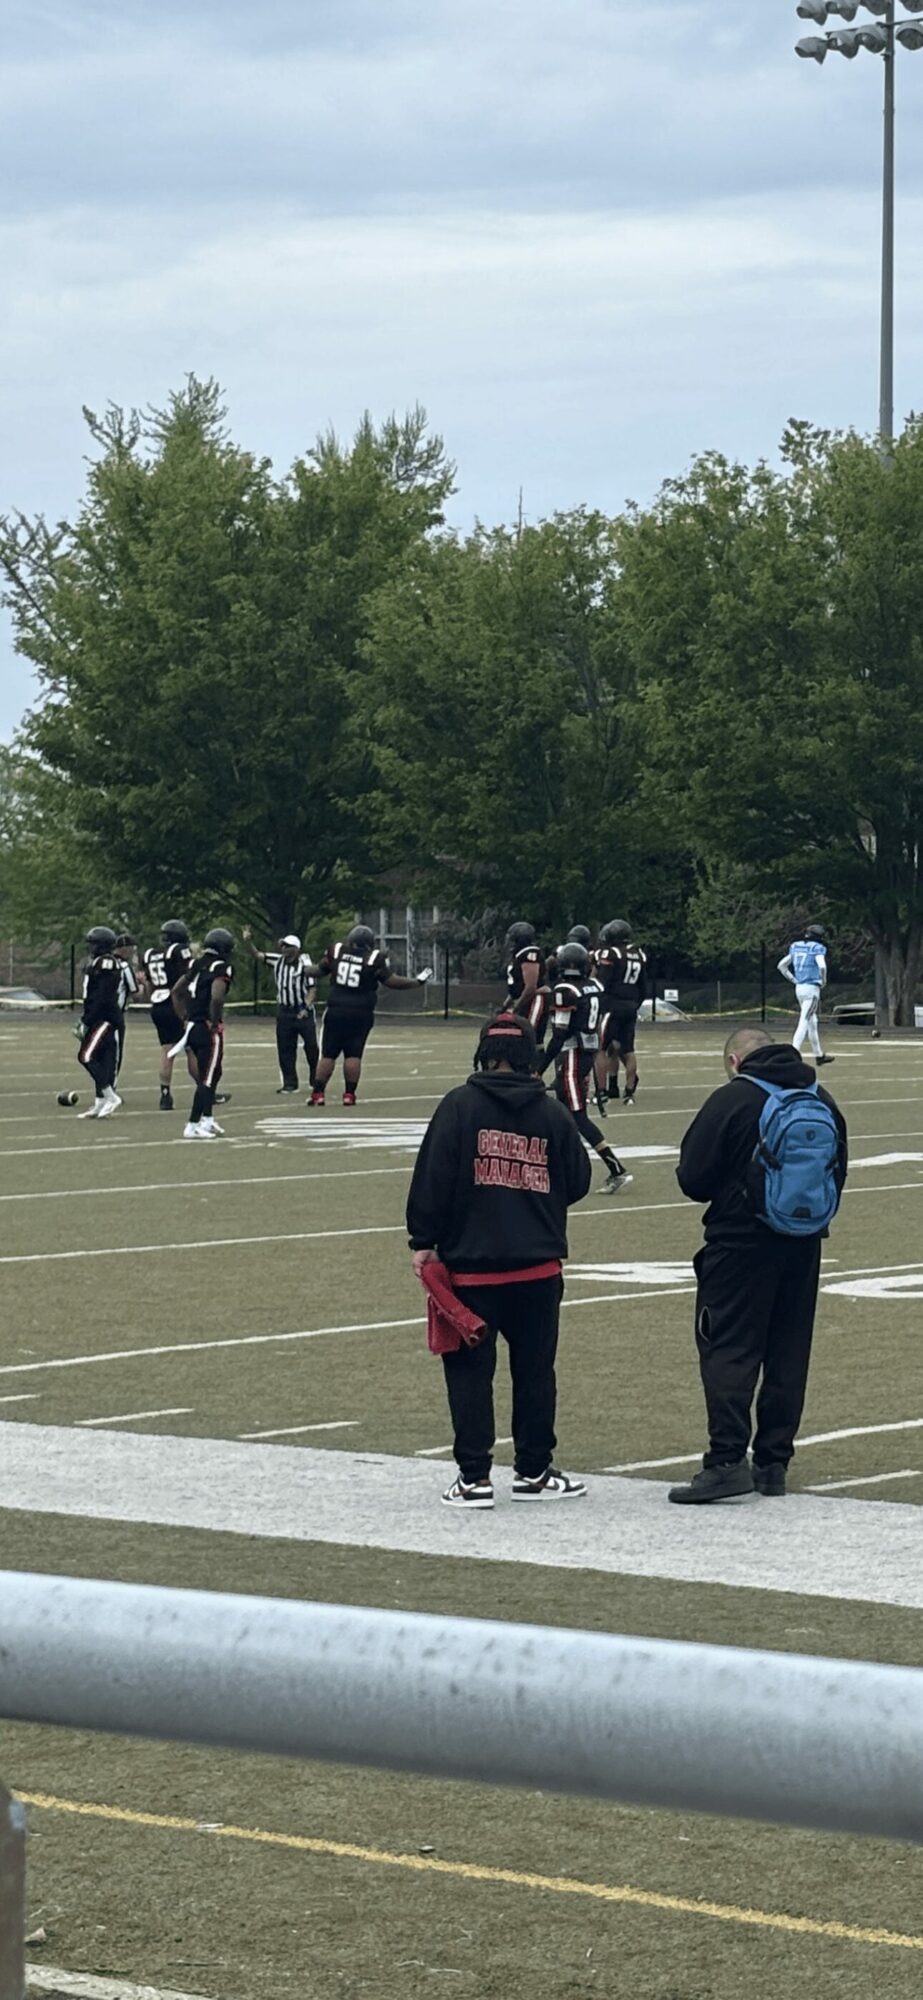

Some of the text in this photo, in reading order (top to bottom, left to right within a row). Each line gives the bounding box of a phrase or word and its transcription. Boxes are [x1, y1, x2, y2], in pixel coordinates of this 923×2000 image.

[149, 962, 168, 986] 55
[336, 961, 362, 988] 95
[624, 961, 641, 984] 13
[588, 996, 599, 1029] 8
[478, 1129, 548, 1165] GENERAL
[474, 1158, 551, 1194] MANAGER
